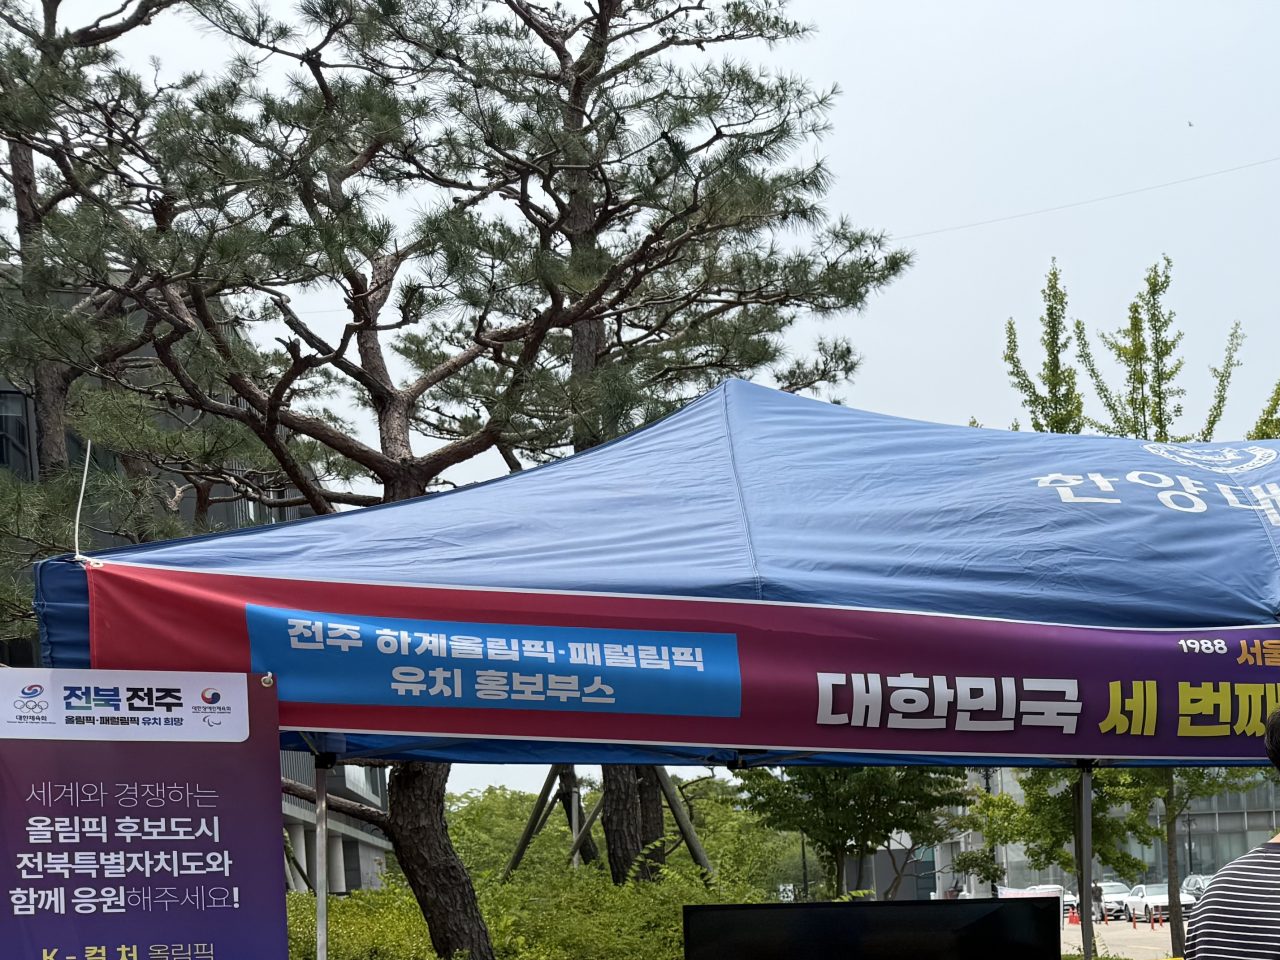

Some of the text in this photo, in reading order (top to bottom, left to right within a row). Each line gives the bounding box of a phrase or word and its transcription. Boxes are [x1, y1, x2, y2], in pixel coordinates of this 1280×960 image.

[287, 617, 705, 672] 전주 하계올림픽·패럴림픽
[1178, 638, 1228, 655] 1988
[391, 665, 616, 704] 유치 홍보부스
[63, 686, 184, 713] 전북 전주
[816, 672, 1083, 735] 대한민국
[1098, 680, 1157, 737] 세
[141, 716, 162, 727] 유치
[163, 716, 184, 727] 희망
[26, 782, 220, 808] 세계와 경쟁하는
[26, 816, 220, 844] 올림픽 후보도시
[16, 850, 233, 879] 전북특별자치도와
[9, 885, 241, 916] 함께 응원해주세요!
